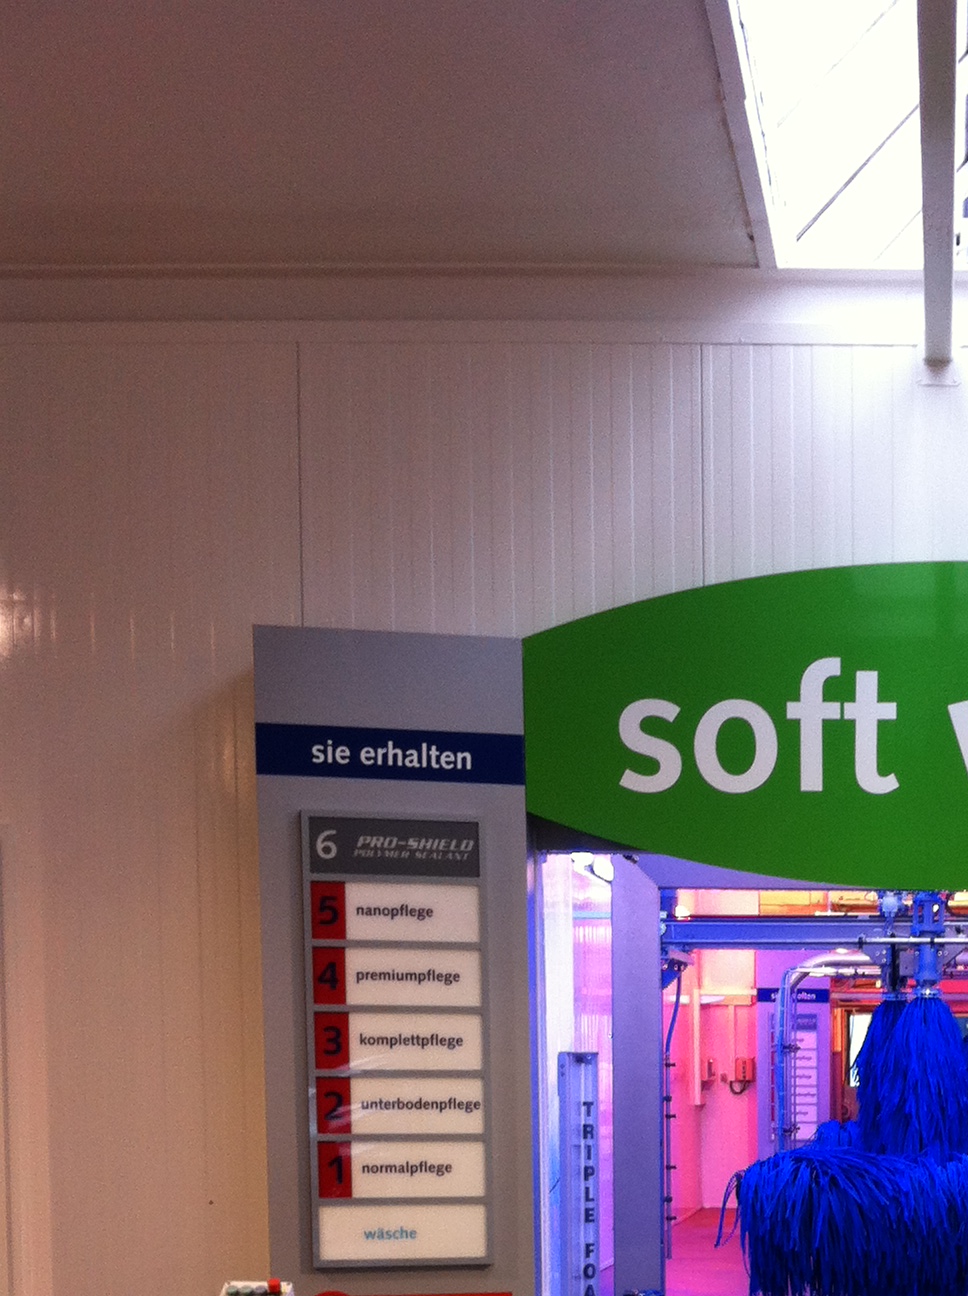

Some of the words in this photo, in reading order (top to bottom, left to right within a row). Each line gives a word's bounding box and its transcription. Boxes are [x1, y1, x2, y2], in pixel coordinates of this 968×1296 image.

[617, 656, 900, 795] soft
[310, 739, 350, 764] sie
[359, 741, 473, 770] erhalten
[316, 829, 338, 859] 6
[357, 835, 475, 851] PRO-SHIELD
[318, 896, 339, 925] 5
[356, 904, 434, 921] nanopflege
[317, 962, 338, 990] 4
[355, 968, 461, 985] premiumpflege
[323, 1026, 342, 1056] 3
[359, 1033, 464, 1049] komplettpflege
[324, 1091, 344, 1120] 2
[361, 1097, 482, 1113] unterbodenpflege
[328, 1155, 344, 1184] 1
[361, 1161, 453, 1176] normalpflege
[582, 1101, 596, 1223] TRIPLE
[363, 1227, 417, 1241] wäsche
